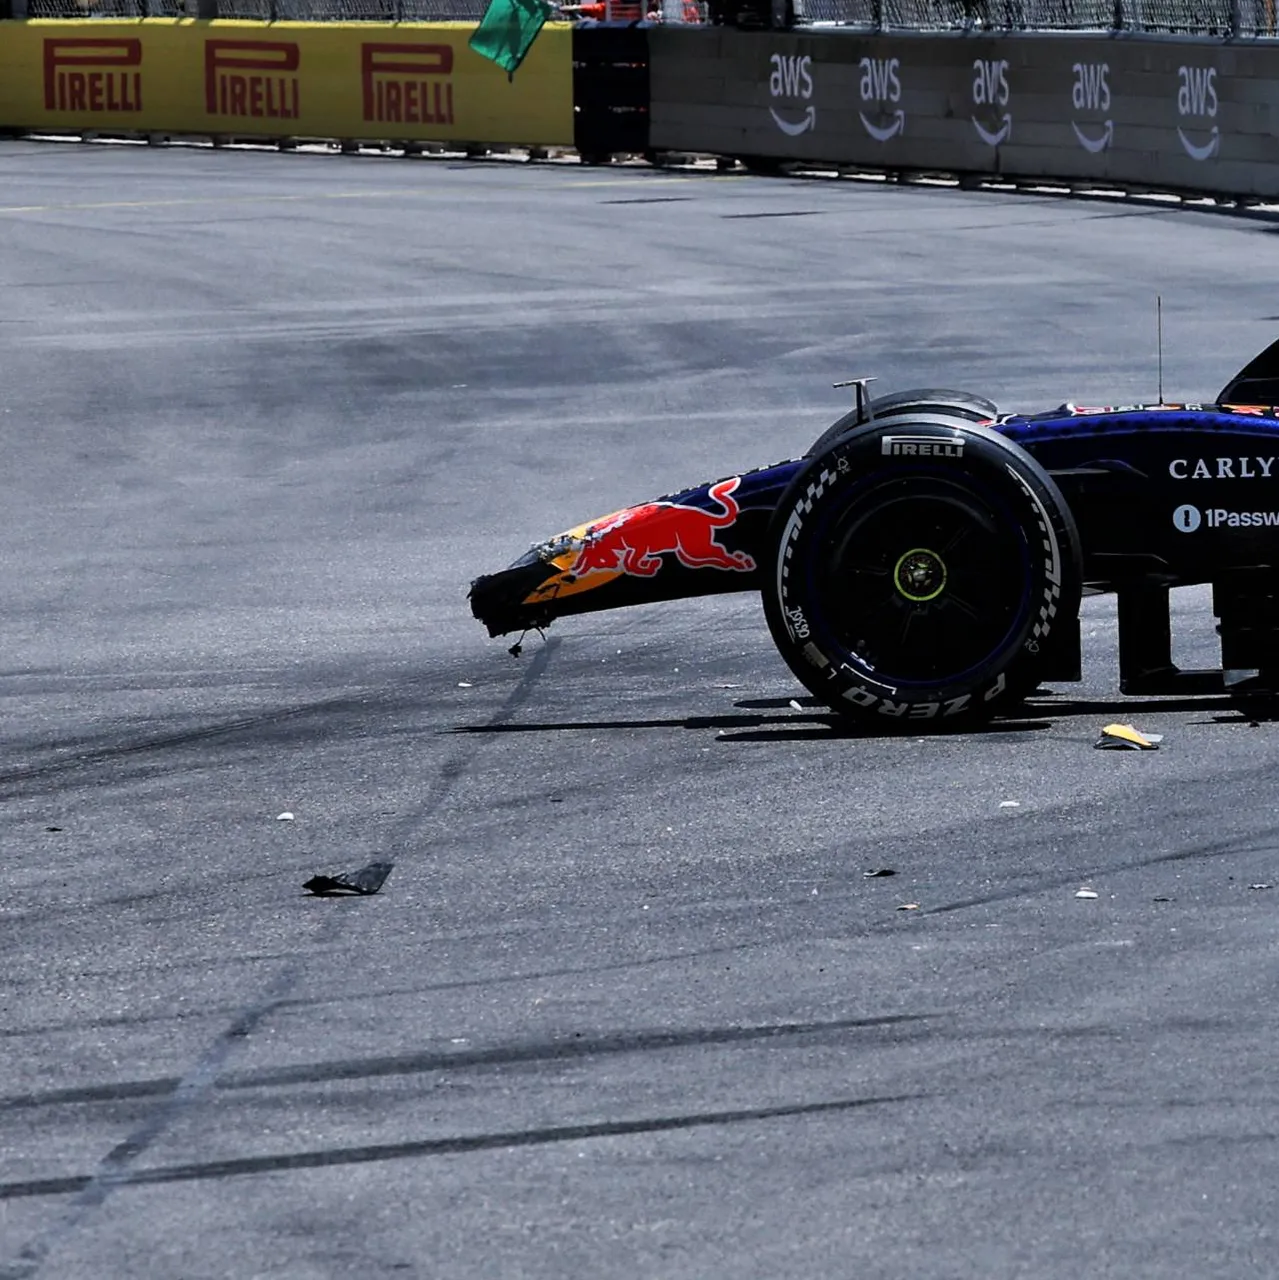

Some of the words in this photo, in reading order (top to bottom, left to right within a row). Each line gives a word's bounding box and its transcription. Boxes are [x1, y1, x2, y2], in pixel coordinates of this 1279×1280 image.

[44, 38, 142, 112] PIRELLI
[205, 39, 299, 119] PIRELLI
[362, 43, 454, 125] PIRELLI
[769, 53, 813, 100] aws
[859, 57, 902, 103] aws
[972, 59, 1010, 106] aws
[1072, 62, 1111, 111] aws
[1177, 65, 1218, 117] aws
[881, 435, 966, 458] PIRELLI
[841, 685, 972, 719] ZERO
